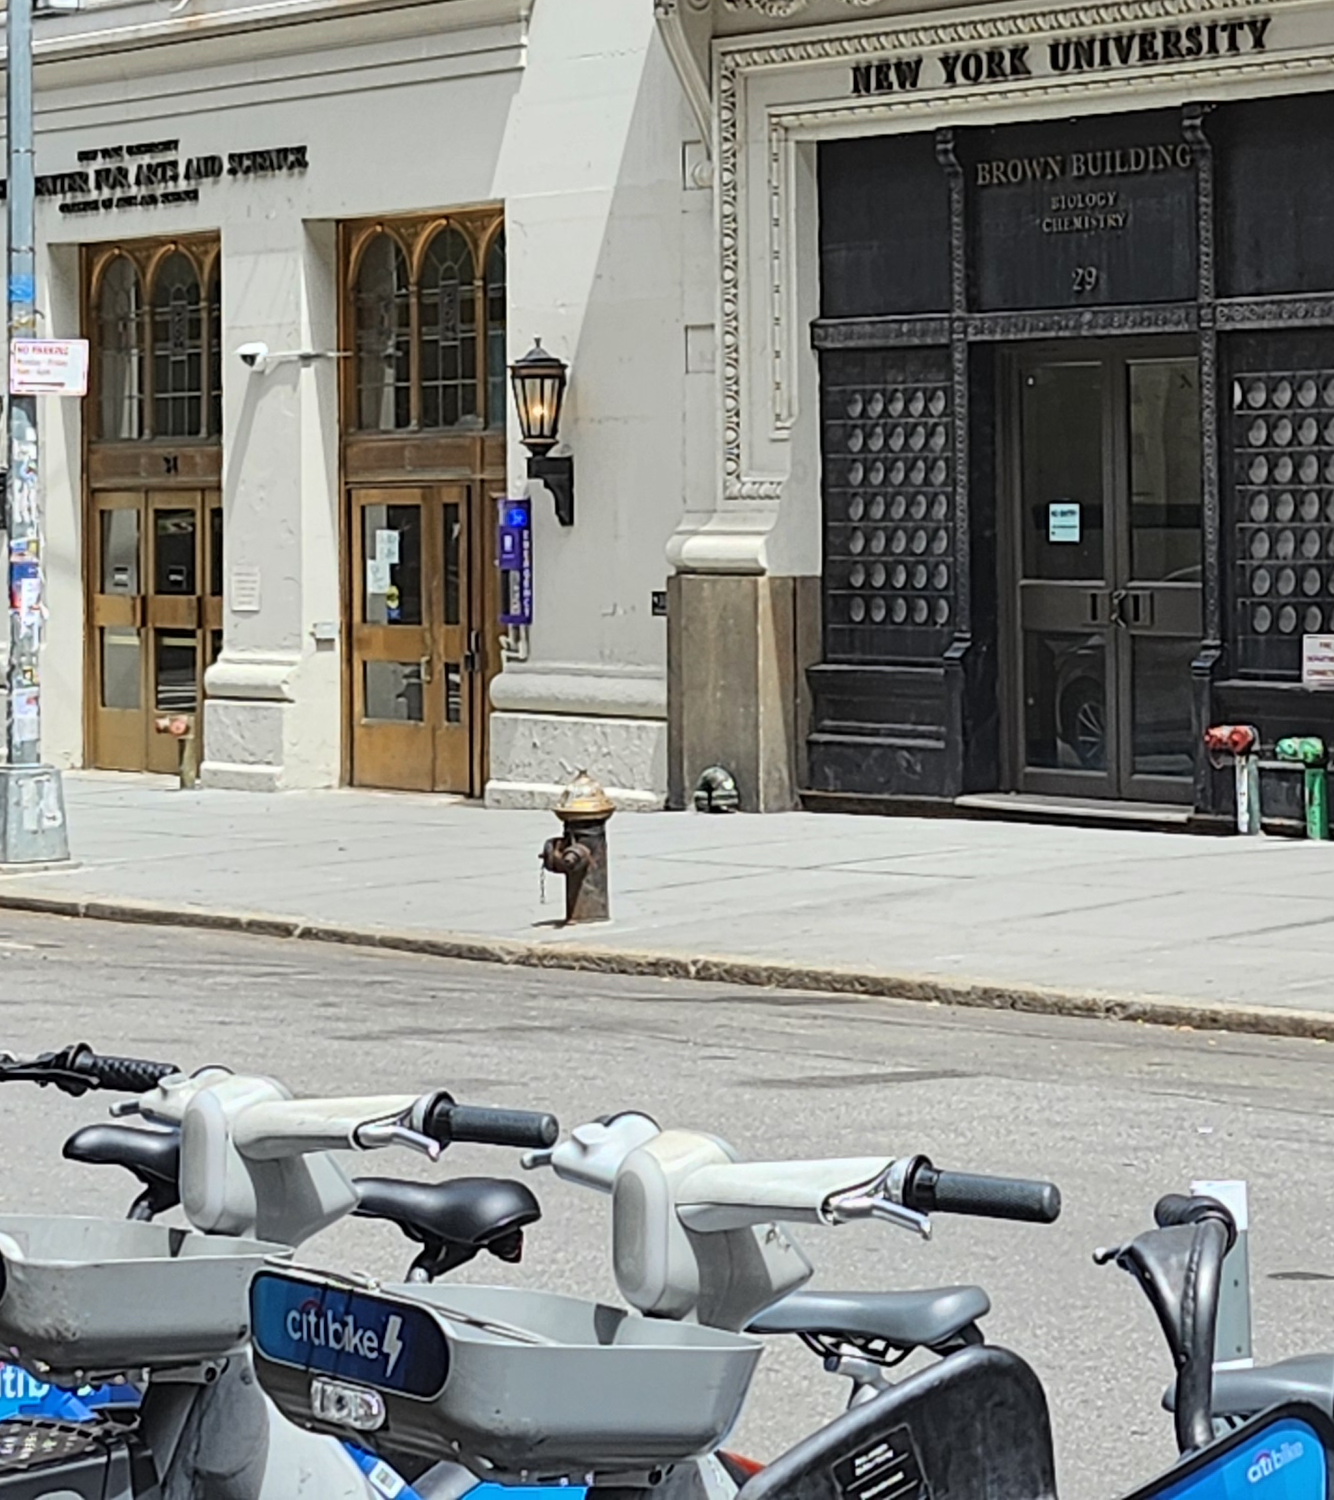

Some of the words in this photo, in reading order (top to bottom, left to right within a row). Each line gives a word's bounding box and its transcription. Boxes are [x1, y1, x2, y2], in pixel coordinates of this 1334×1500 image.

[851, 57, 923, 96] NEW
[939, 44, 1032, 84] YORK
[1048, 16, 1272, 72] UNIVERSITY
[94, 165, 132, 192] FOR
[134, 159, 179, 187] ARTS
[184, 154, 223, 181] AND
[976, 155, 1063, 186] BROWN
[1071, 142, 1193, 178] BUILDING
[1050, 191, 1118, 211] BIOLOGY
[1041, 212, 1129, 233] CHEMISTRY
[1071, 266, 1097, 291] 29
[286, 1306, 325, 1346] citi
[327, 1309, 378, 1359] bike
